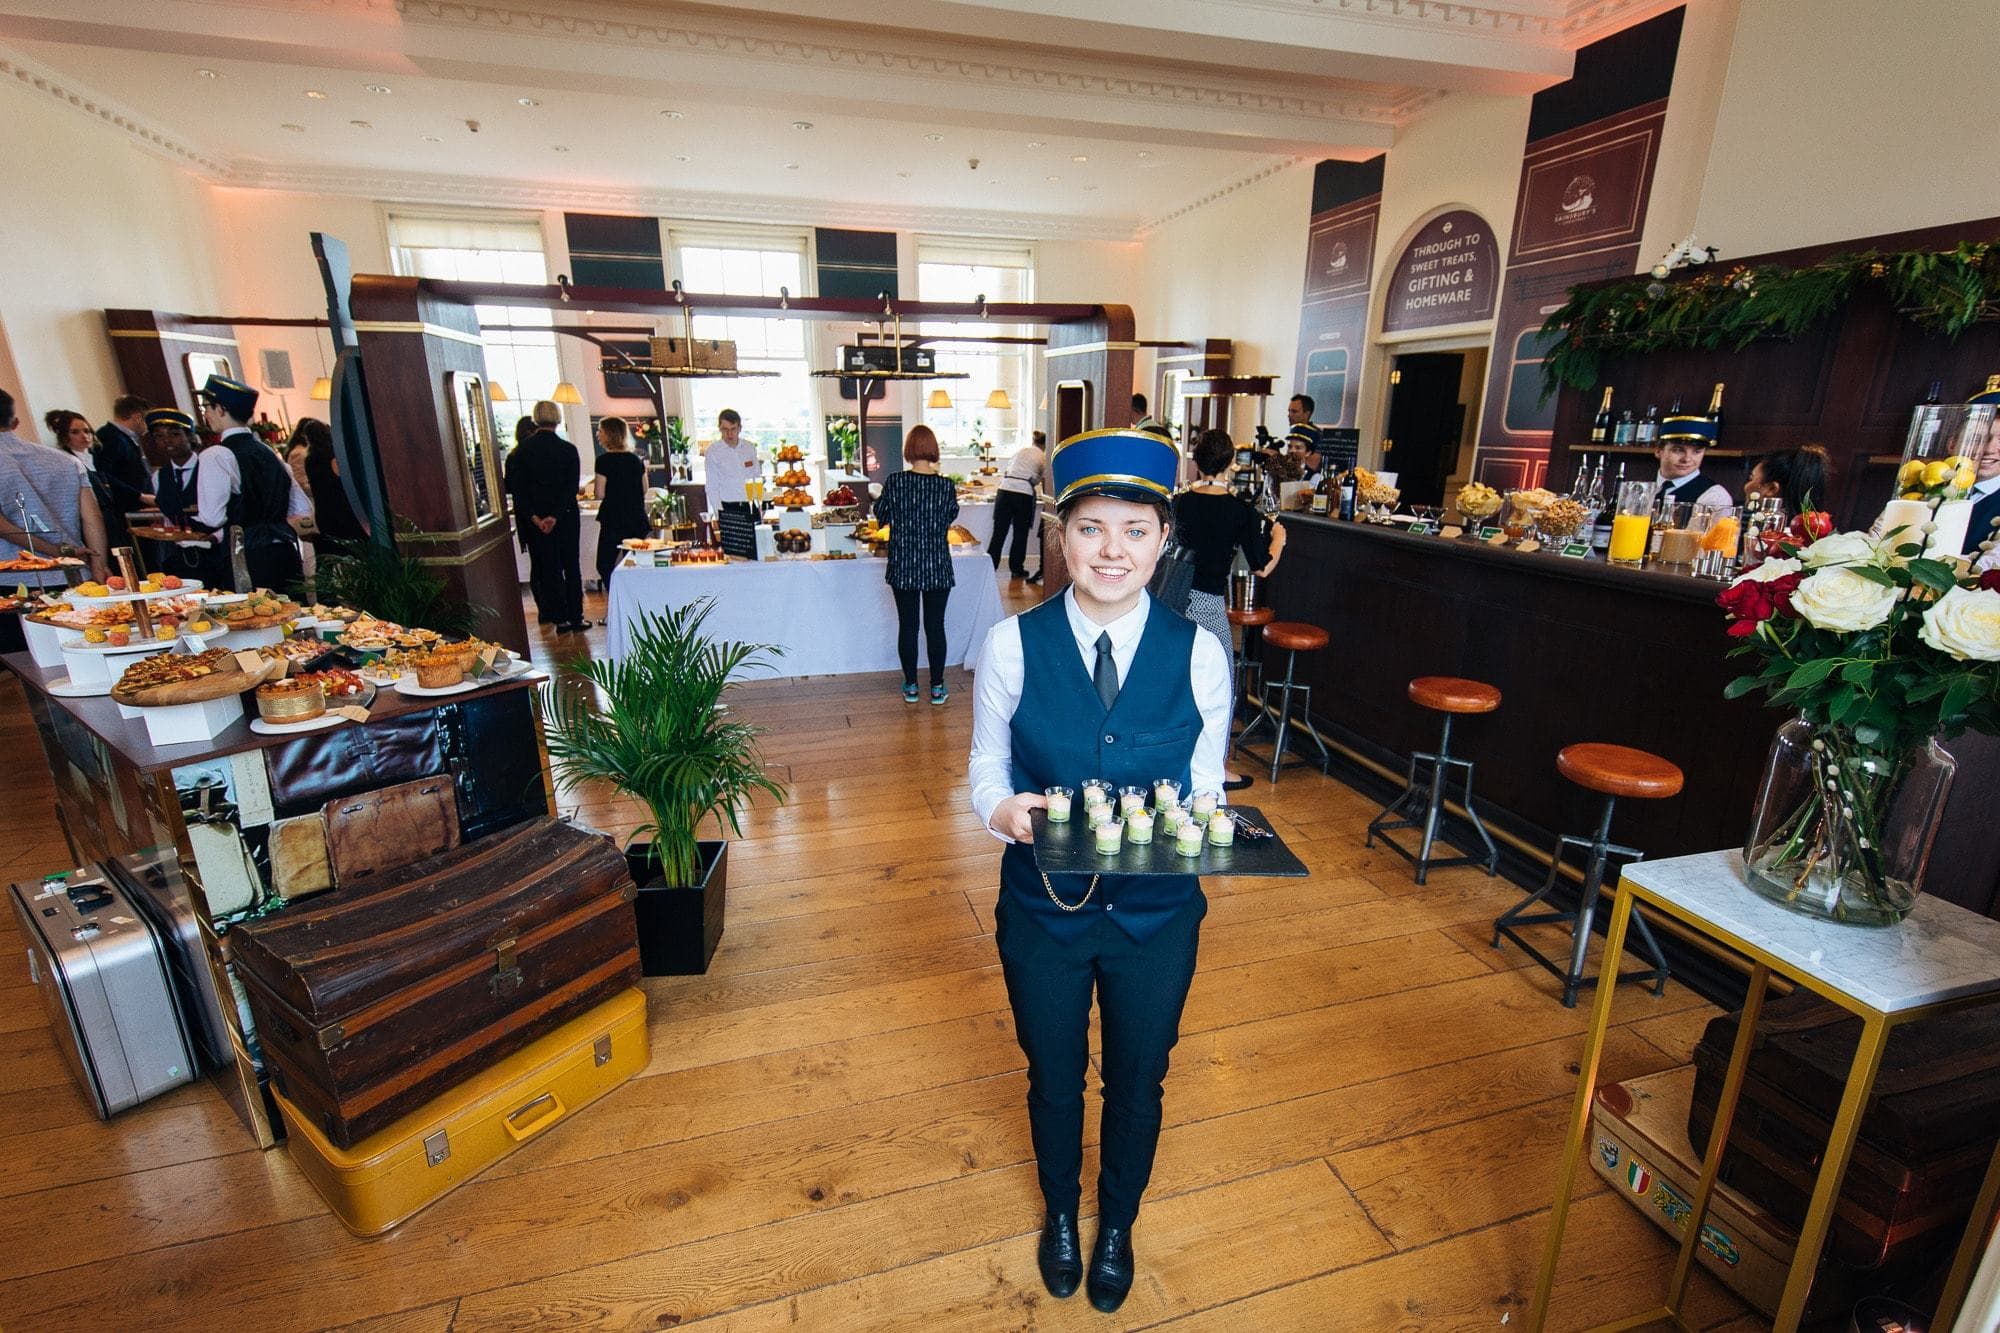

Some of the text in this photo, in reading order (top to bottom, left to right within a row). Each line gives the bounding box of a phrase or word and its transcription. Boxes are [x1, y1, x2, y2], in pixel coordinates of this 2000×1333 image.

[1413, 233, 1480, 258] THROUGH TO
[1410, 251, 1477, 274] SWEET TREATS,
[1408, 268, 1474, 292] GIFTING &
[1405, 288, 1472, 310] HOMEWARE
